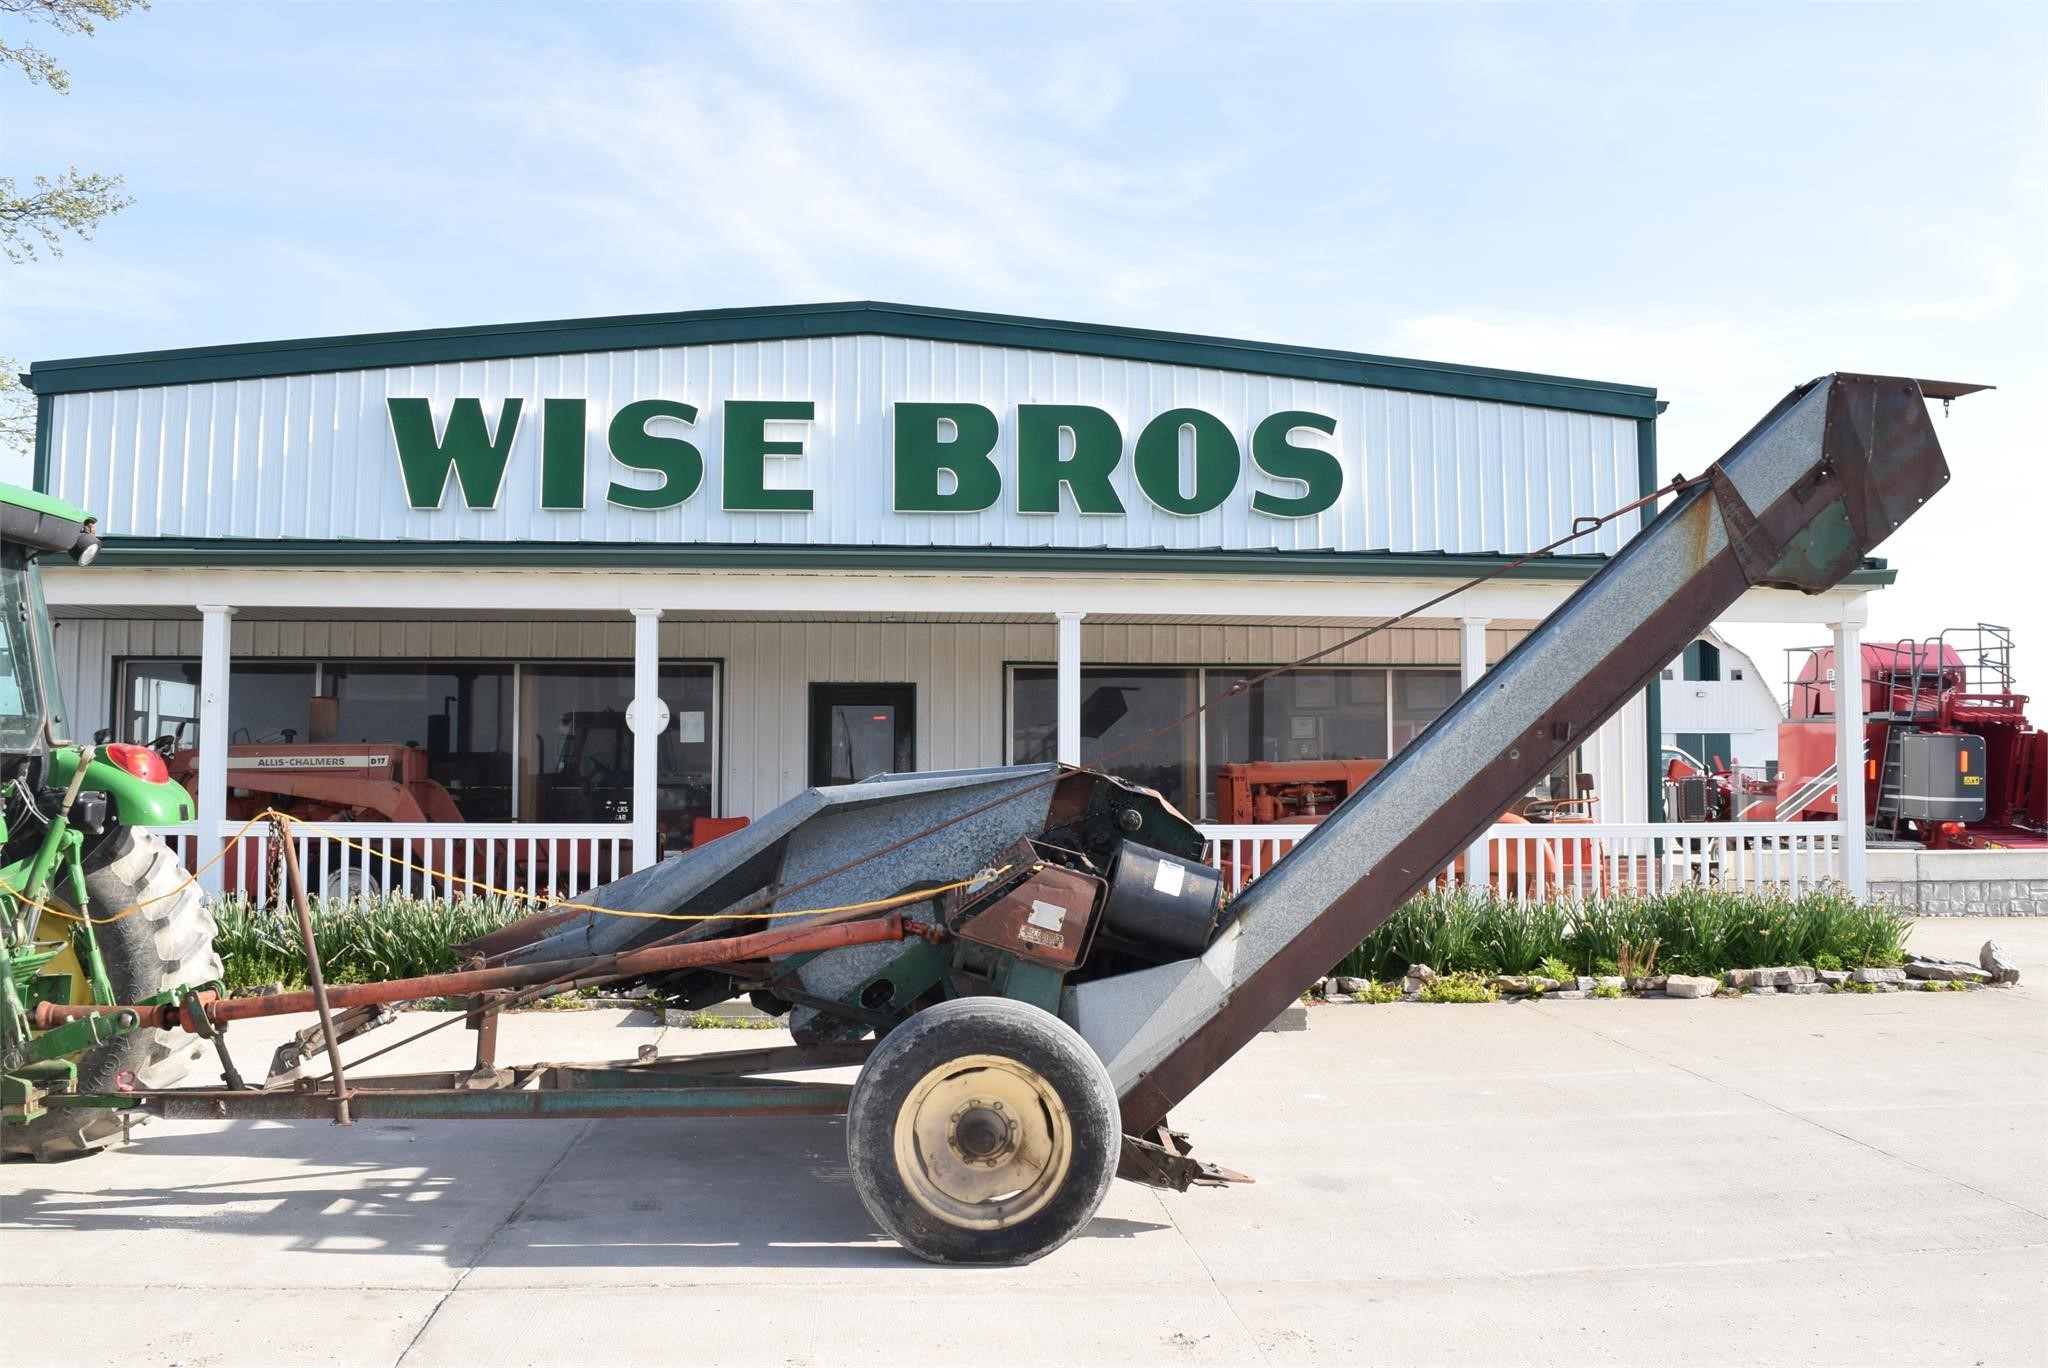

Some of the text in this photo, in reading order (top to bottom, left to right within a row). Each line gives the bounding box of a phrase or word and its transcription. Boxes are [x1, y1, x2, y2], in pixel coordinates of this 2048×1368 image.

[386, 397, 1344, 518] WISE BROS
[257, 757, 345, 767] ALLIS-CHALMERS
